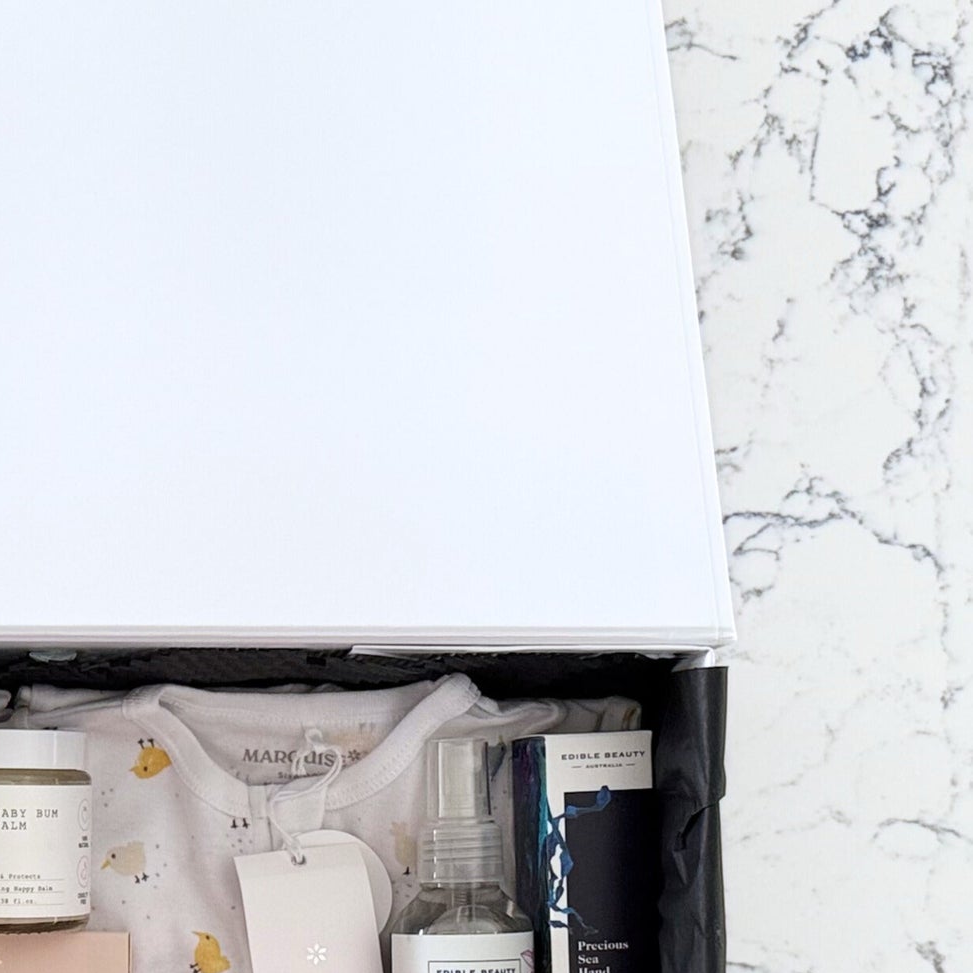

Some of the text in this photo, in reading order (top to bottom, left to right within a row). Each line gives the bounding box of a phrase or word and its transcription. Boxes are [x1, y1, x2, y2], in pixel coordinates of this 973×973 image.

[561, 750, 645, 760] EDIBLE BEAUTY
[36, 808, 59, 818] BUM
[577, 940, 629, 951] Precious
[578, 954, 599, 964] Sea
